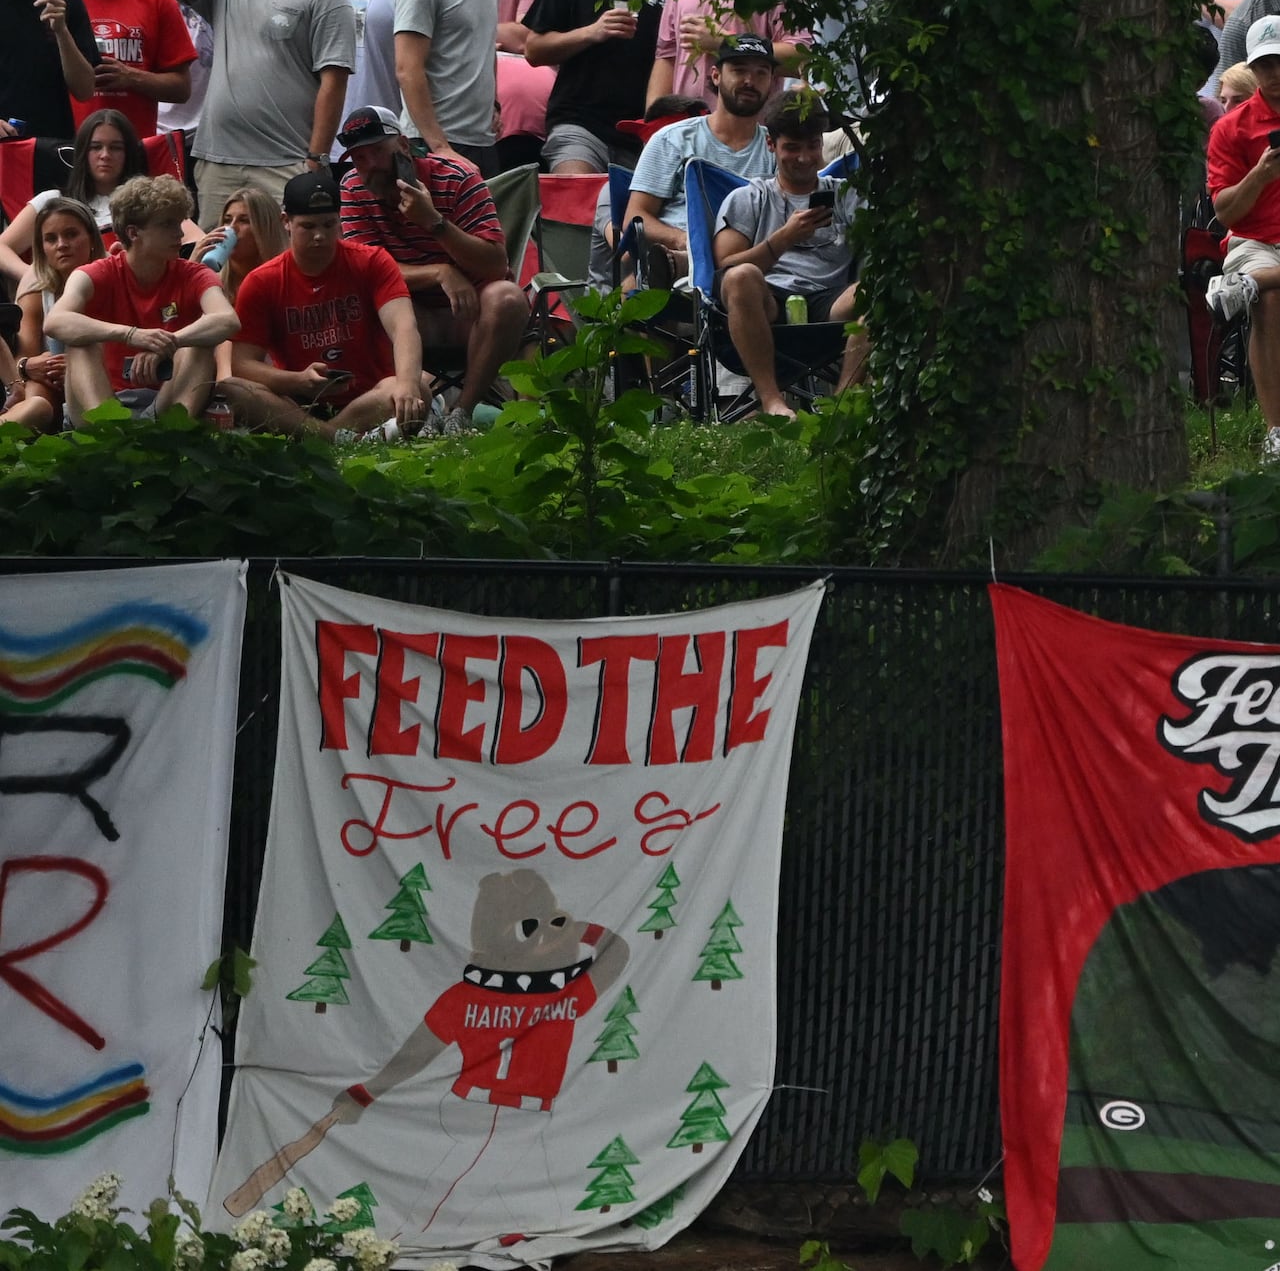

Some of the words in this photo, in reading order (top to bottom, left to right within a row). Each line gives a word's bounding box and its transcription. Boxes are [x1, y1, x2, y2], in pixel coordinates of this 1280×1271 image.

[315, 618, 568, 765] FEED
[577, 618, 789, 766] THE
[339, 773, 721, 860] Trees
[464, 1003, 526, 1028] HAIRY
[528, 997, 578, 1027] DAWG
[496, 1037, 515, 1080] 1
